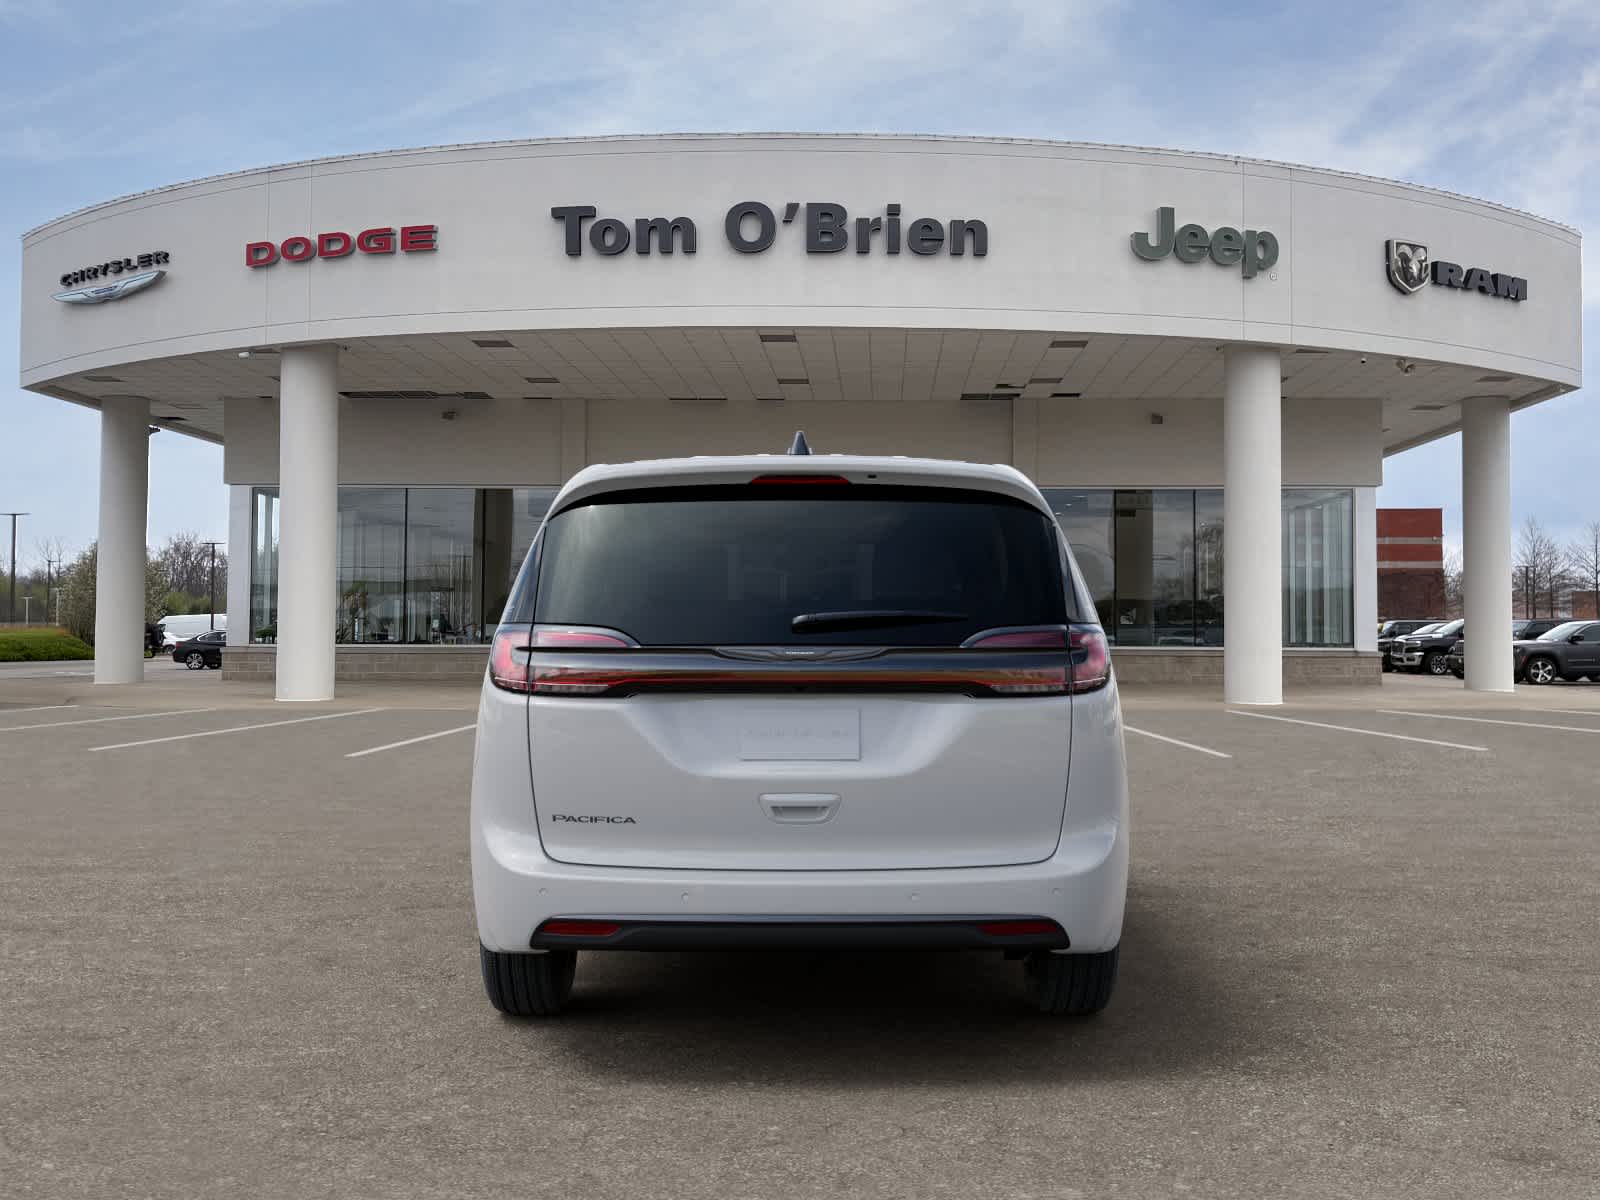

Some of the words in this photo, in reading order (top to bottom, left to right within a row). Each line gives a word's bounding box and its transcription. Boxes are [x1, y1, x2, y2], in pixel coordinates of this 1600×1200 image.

[245, 225, 437, 268] DODGE
[551, 205, 696, 257] Tom
[724, 201, 988, 257] O'Brien
[1130, 206, 1280, 280] Jeep
[59, 250, 170, 288] CHRYSLER
[1431, 260, 1528, 301] RAM
[552, 814, 636, 824] PACIFICA
